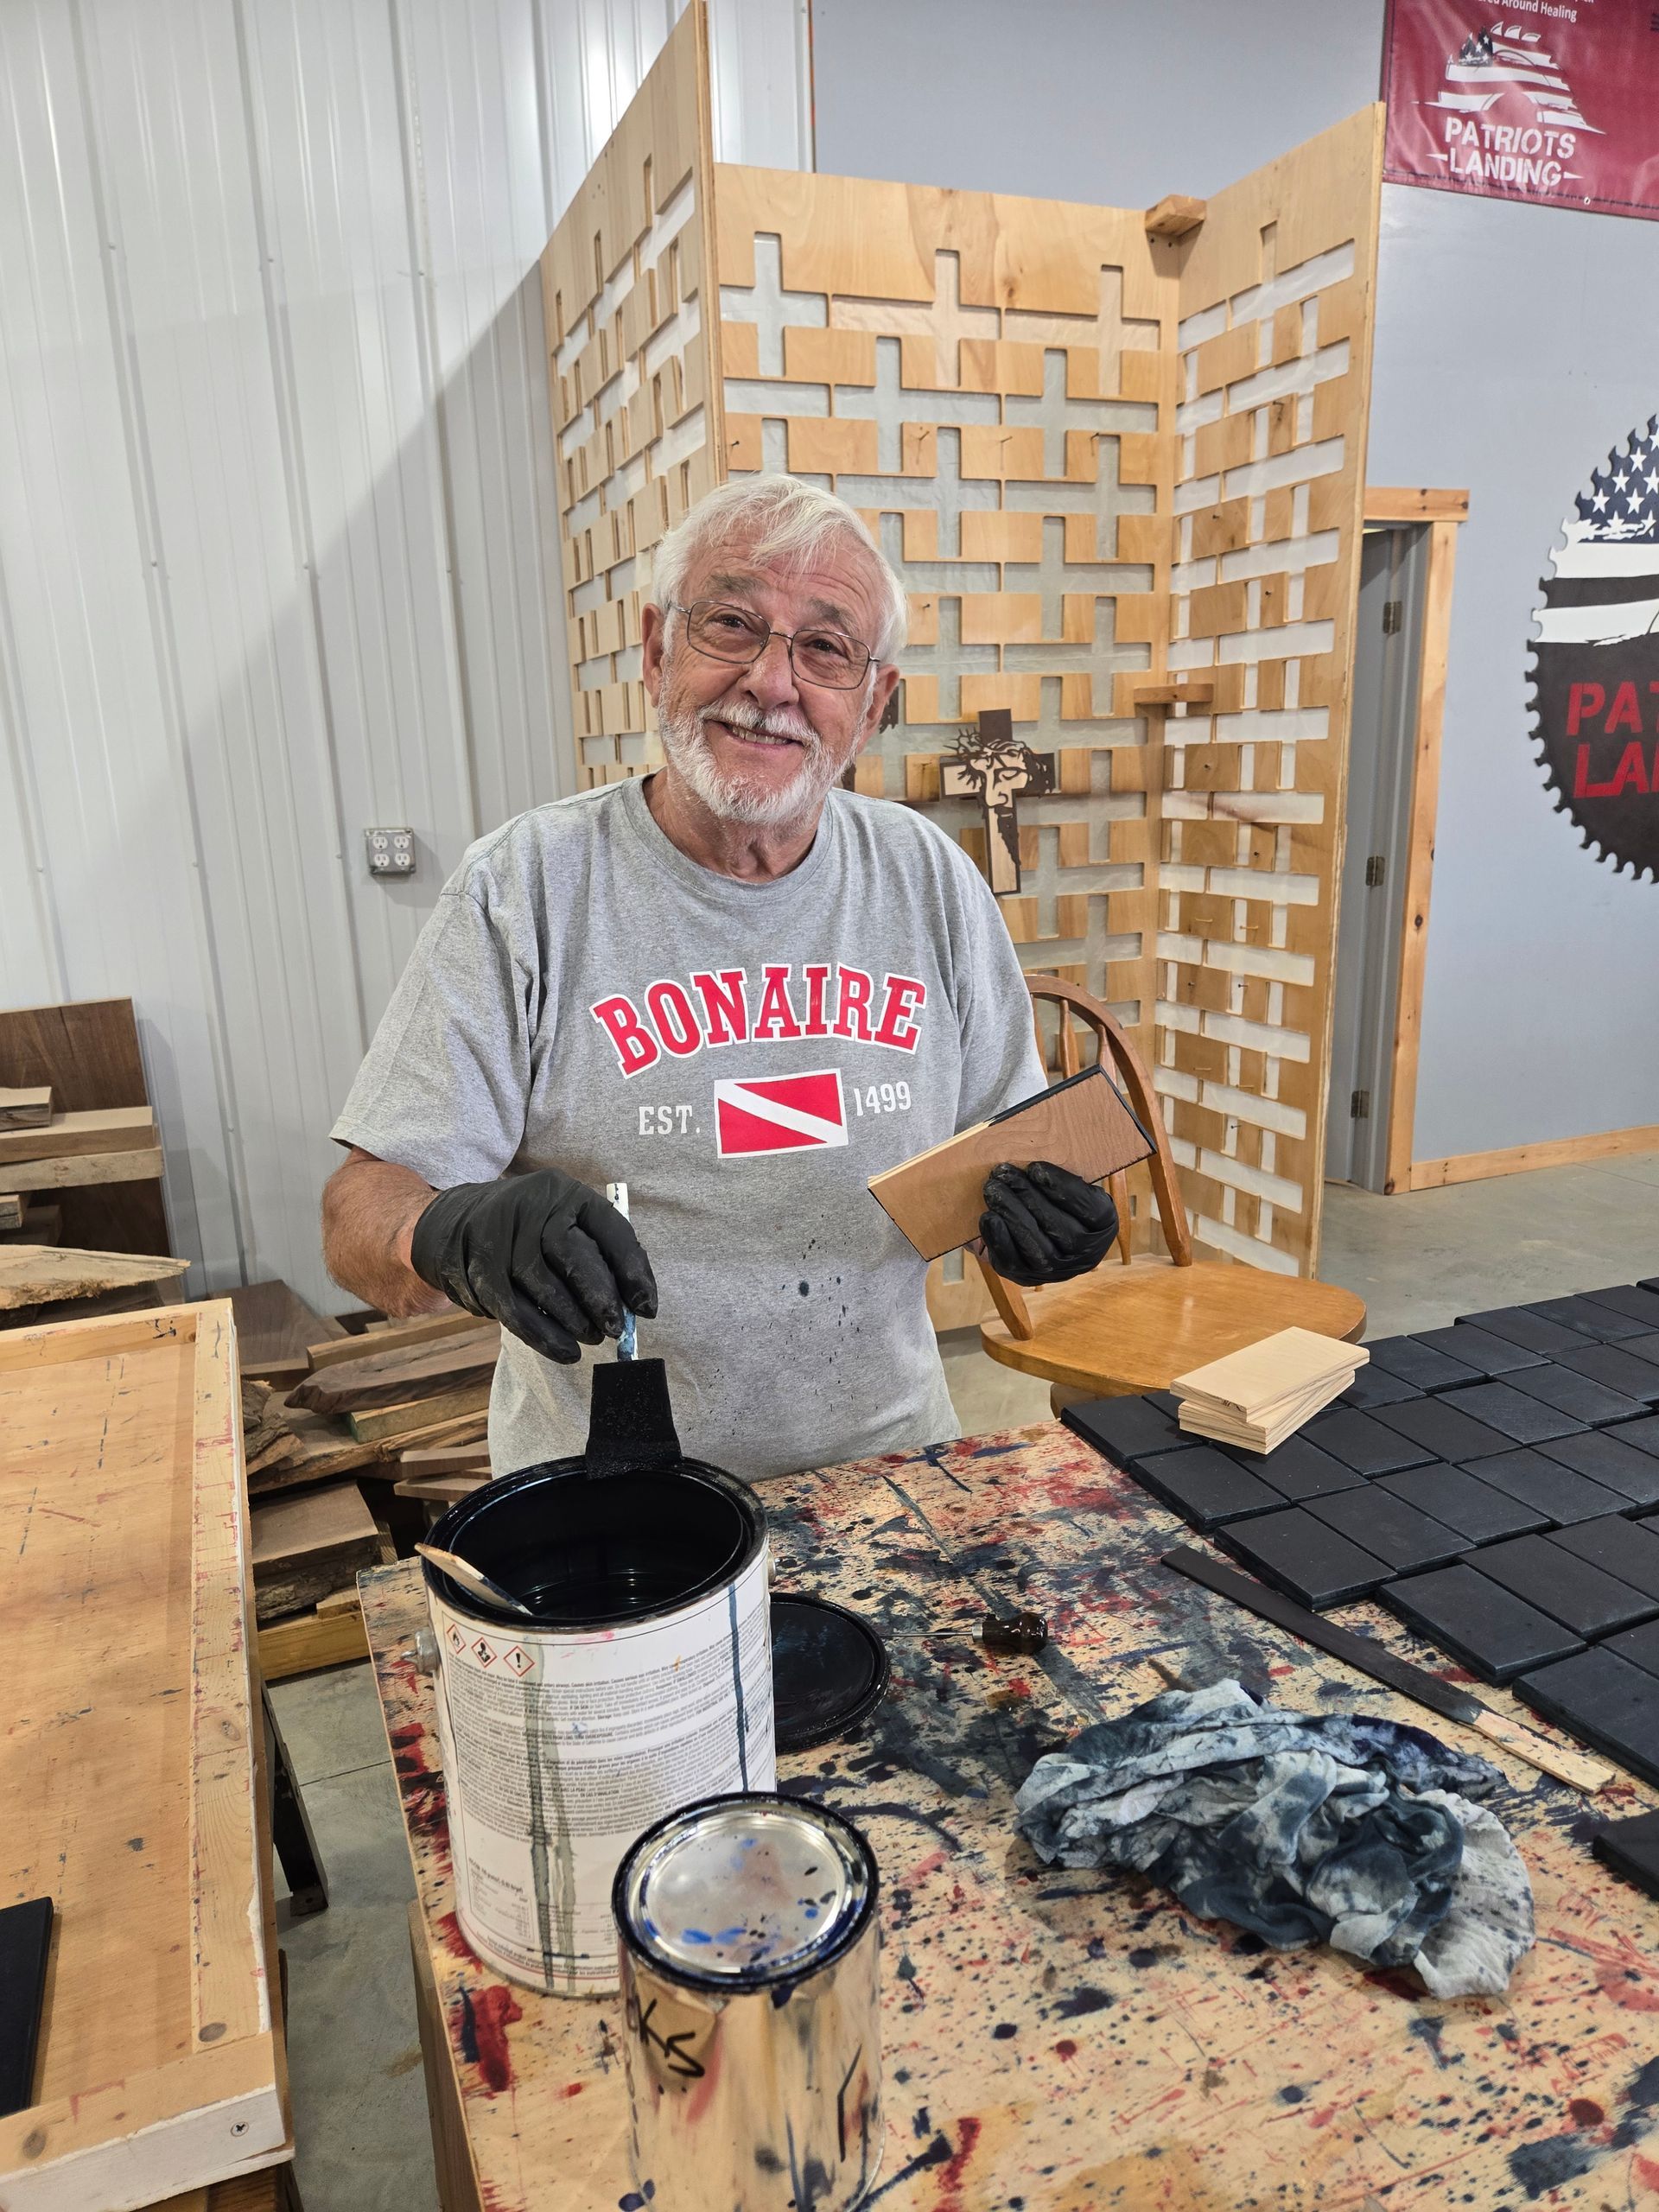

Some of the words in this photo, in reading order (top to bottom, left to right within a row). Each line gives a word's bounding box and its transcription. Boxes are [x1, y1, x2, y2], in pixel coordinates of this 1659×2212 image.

[1501, 0, 1538, 13] Around
[1541, 2, 1577, 22] Healing
[1445, 117, 1576, 159] PATRIOTS
[1450, 148, 1561, 187] LANDING
[1567, 681, 1659, 736] PA
[588, 962, 927, 1079] BONAIRE
[639, 1105, 701, 1135] EST.
[855, 1081, 912, 1117] 1499
